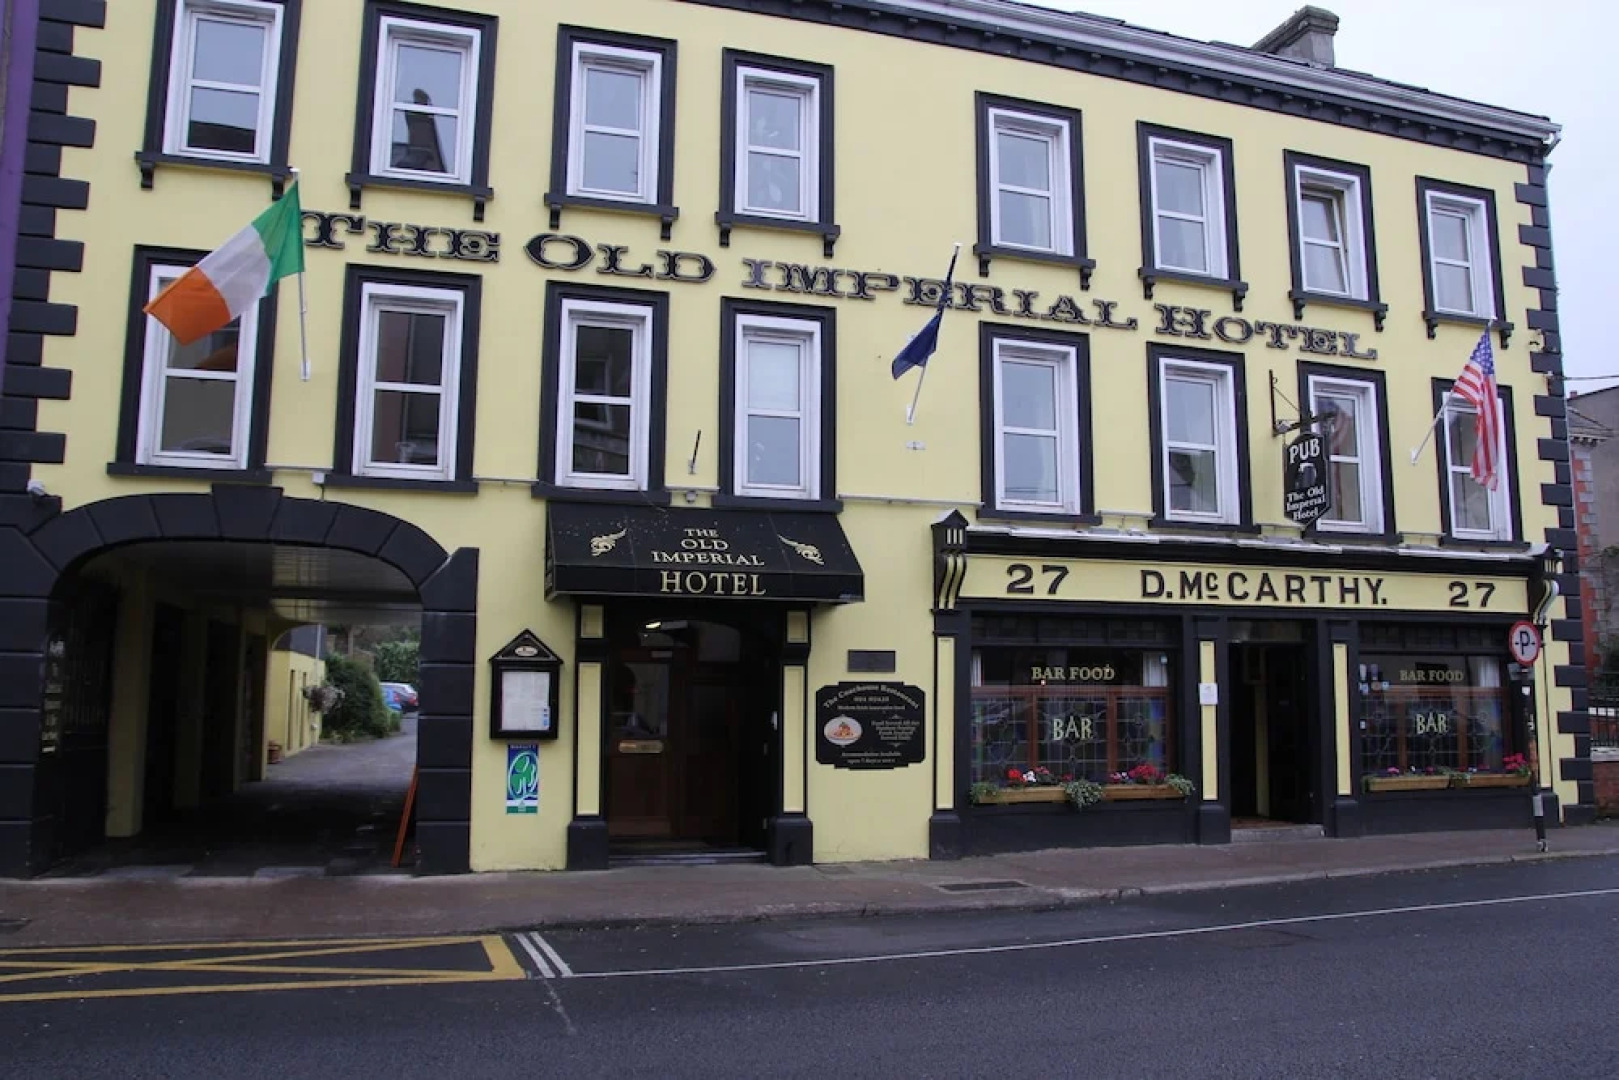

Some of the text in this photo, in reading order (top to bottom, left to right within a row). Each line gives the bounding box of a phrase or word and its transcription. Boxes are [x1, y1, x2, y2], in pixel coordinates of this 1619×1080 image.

[300, 210, 1377, 359] THE OLD IMPERIAL HOTEL
[1289, 438, 1320, 464] PUB
[1286, 494, 1326, 513] Imperial
[1287, 485, 1324, 503] The Old
[1293, 507, 1319, 520] Hotel
[683, 528, 719, 537] THE
[681, 539, 728, 550] OLD
[651, 551, 765, 566] IMPERIAL
[660, 570, 766, 595] HOTEL
[1006, 563, 1070, 595] 27
[1448, 580, 1496, 608] 27
[1519, 630, 1531, 655] P
[1031, 665, 1115, 680] BAR FOOD
[1400, 669, 1464, 682] BAR FOOD
[1053, 716, 1094, 741] BAR
[1416, 712, 1448, 735] BAR
